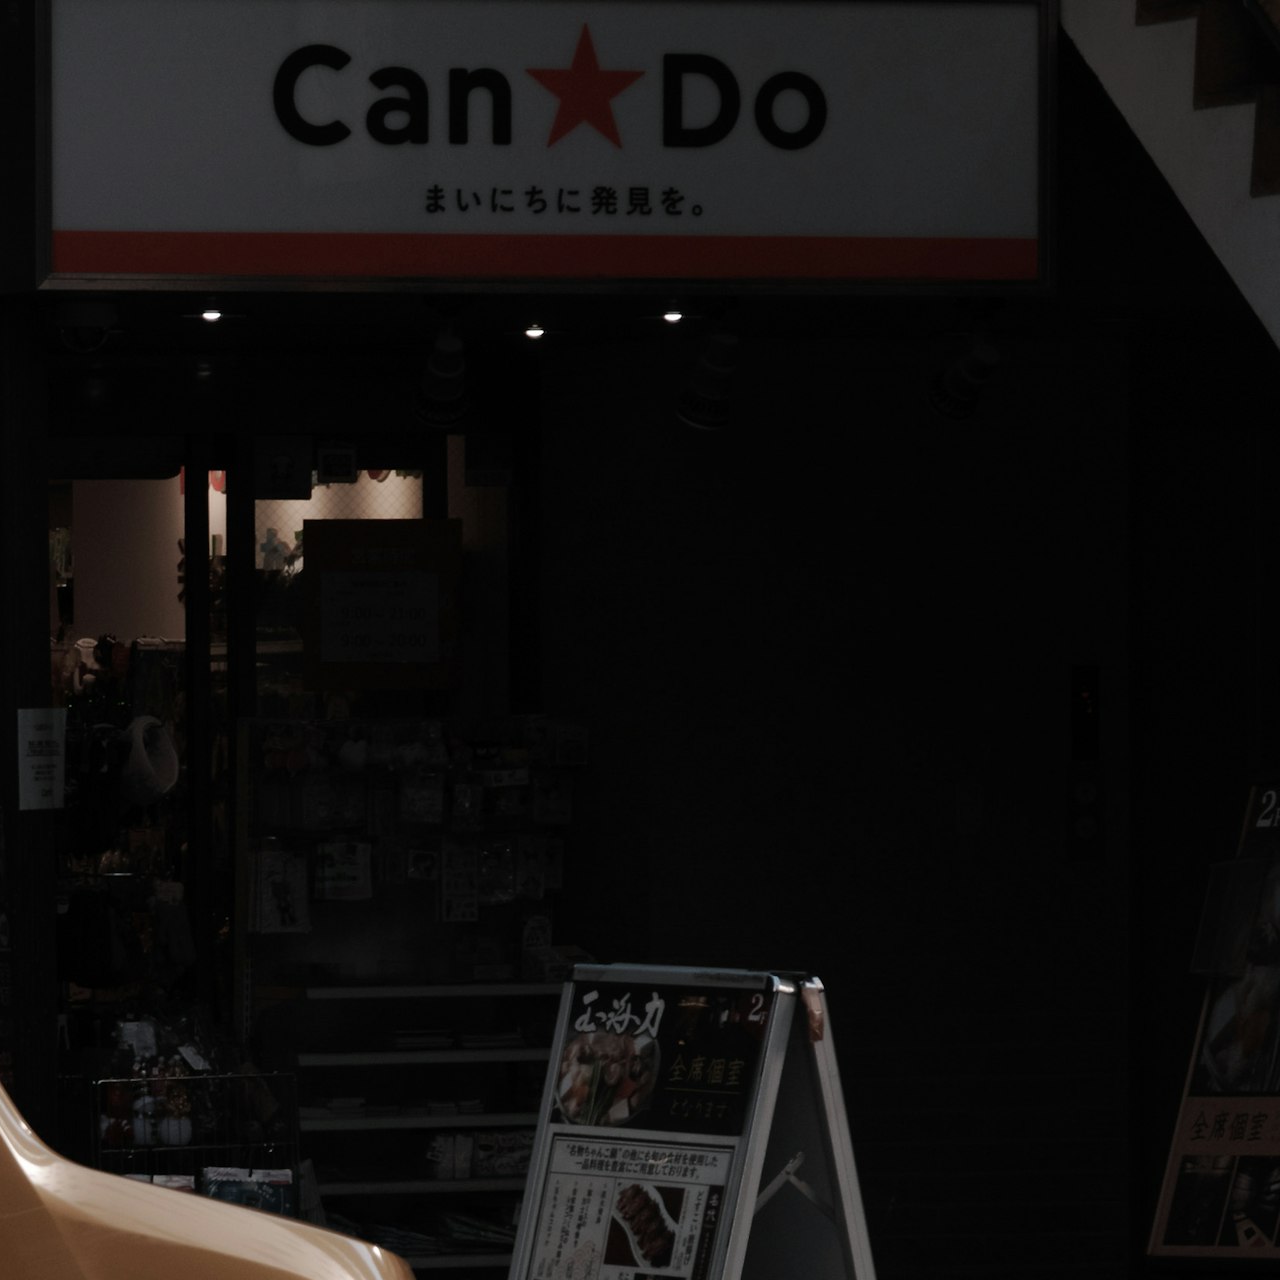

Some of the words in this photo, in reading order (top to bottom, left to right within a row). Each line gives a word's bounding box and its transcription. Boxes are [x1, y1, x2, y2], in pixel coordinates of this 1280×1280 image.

[273, 43, 512, 147] Can
[662, 53, 828, 150] Do
[423, 185, 706, 217] まいにちに発見を。
[668, 1053, 745, 1086] 全席個室
[1190, 1109, 1268, 1141] 全席個室
